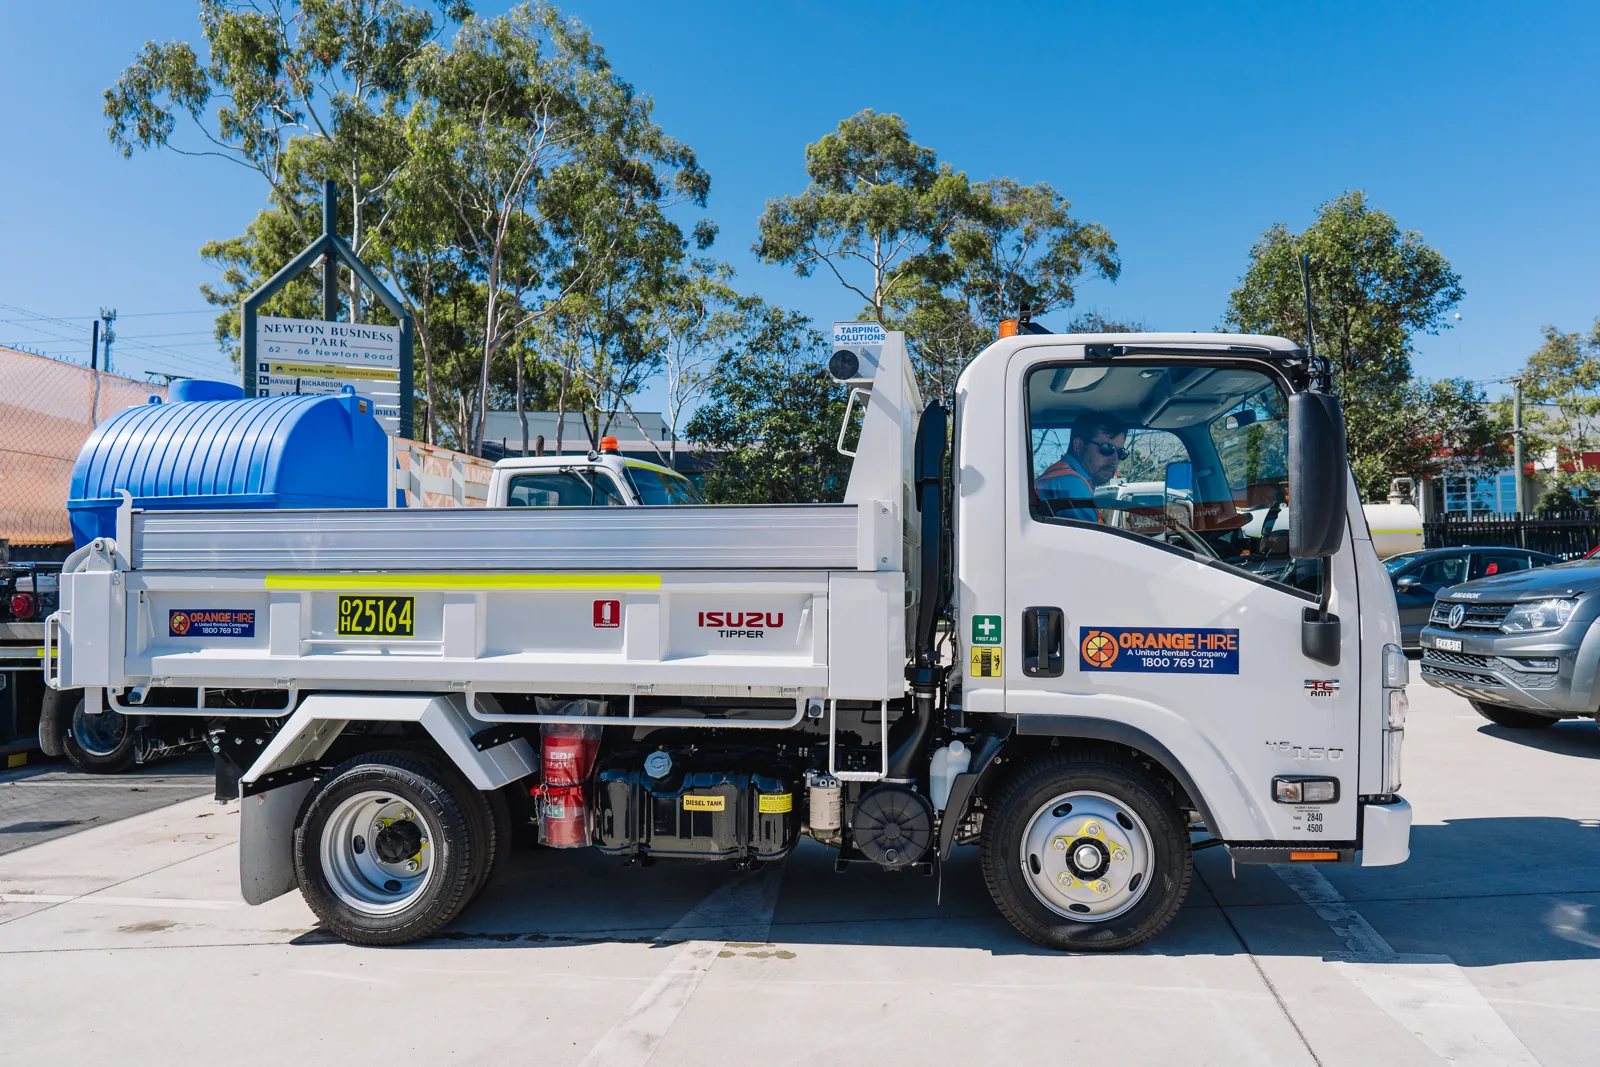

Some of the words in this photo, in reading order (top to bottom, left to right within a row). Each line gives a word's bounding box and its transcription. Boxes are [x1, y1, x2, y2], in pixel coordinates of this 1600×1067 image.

[264, 324, 324, 335] NEWTON
[330, 326, 393, 342] BUSINESS
[311, 337, 348, 348] PARK
[316, 349, 358, 358] Newton
[364, 352, 393, 360] Road
[190, 613, 231, 622] ORANGE
[232, 613, 254, 623] HIRE
[351, 599, 412, 632] 25164
[698, 612, 783, 628] ISUZU
[718, 630, 764, 638] TIPPER
[1119, 633, 1195, 649] ORANGE
[1198, 634, 1237, 650] HIRE
[1142, 658, 1170, 667] 1800
[1173, 658, 1195, 668] 769
[1199, 659, 1214, 668] 121
[1307, 813, 1323, 822] 2840
[1307, 824, 1323, 832] 4500
